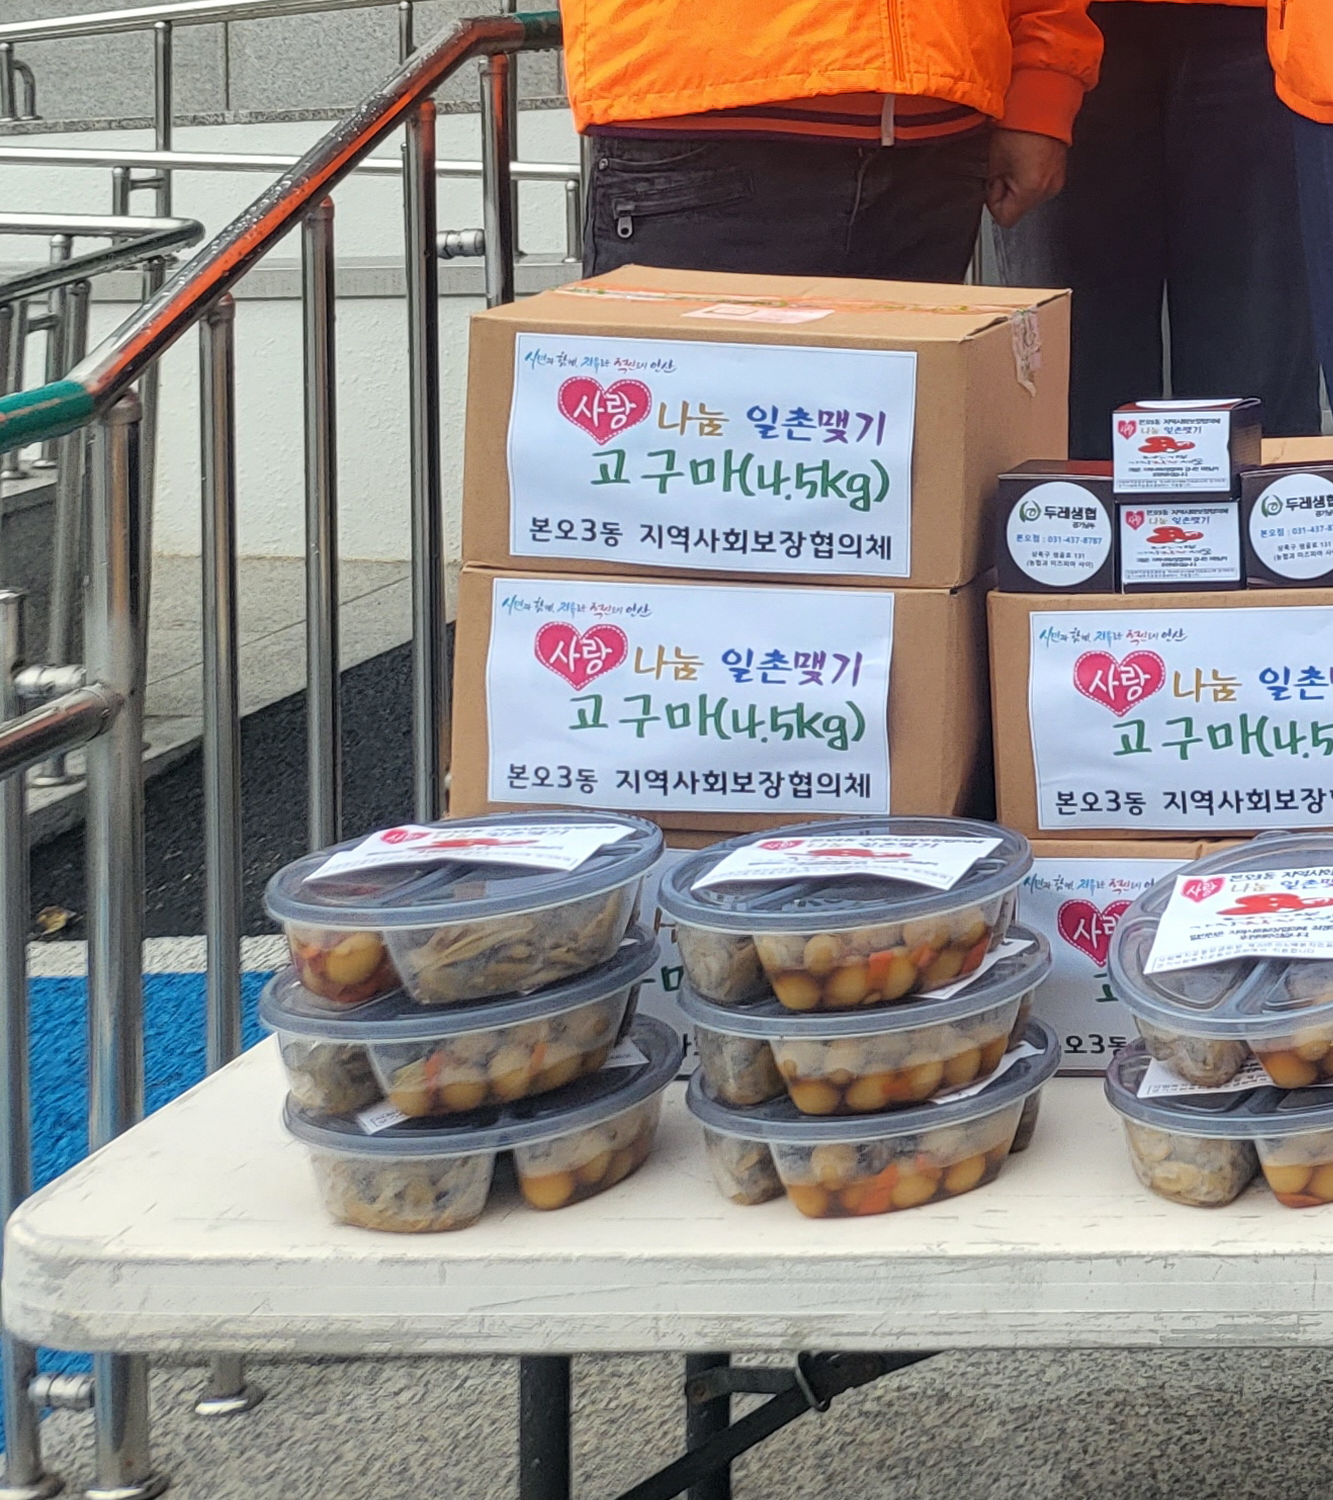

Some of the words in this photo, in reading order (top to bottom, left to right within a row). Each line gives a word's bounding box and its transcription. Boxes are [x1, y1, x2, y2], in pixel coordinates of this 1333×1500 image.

[573, 391, 637, 428] 사랑
[658, 401, 730, 437] 나눔
[747, 405, 887, 445] 일촌맺기
[591, 448, 890, 512] 고구마(4.5kg)
[1044, 506, 1097, 520] 두레생협
[530, 517, 622, 547] 본오3동
[640, 523, 892, 560] 지역사회보장협의체
[550, 635, 613, 672] 사랑
[635, 645, 704, 680] 나눔
[722, 648, 863, 687] 일촌맺기
[1089, 664, 1151, 701] 사랑
[1174, 667, 1242, 702] 나눔
[569, 694, 865, 751] 고구마(4.5kg)
[507, 764, 598, 794] 본오3동
[617, 769, 870, 798] 지역사회보장협의체
[1056, 790, 1146, 816] 본오3동
